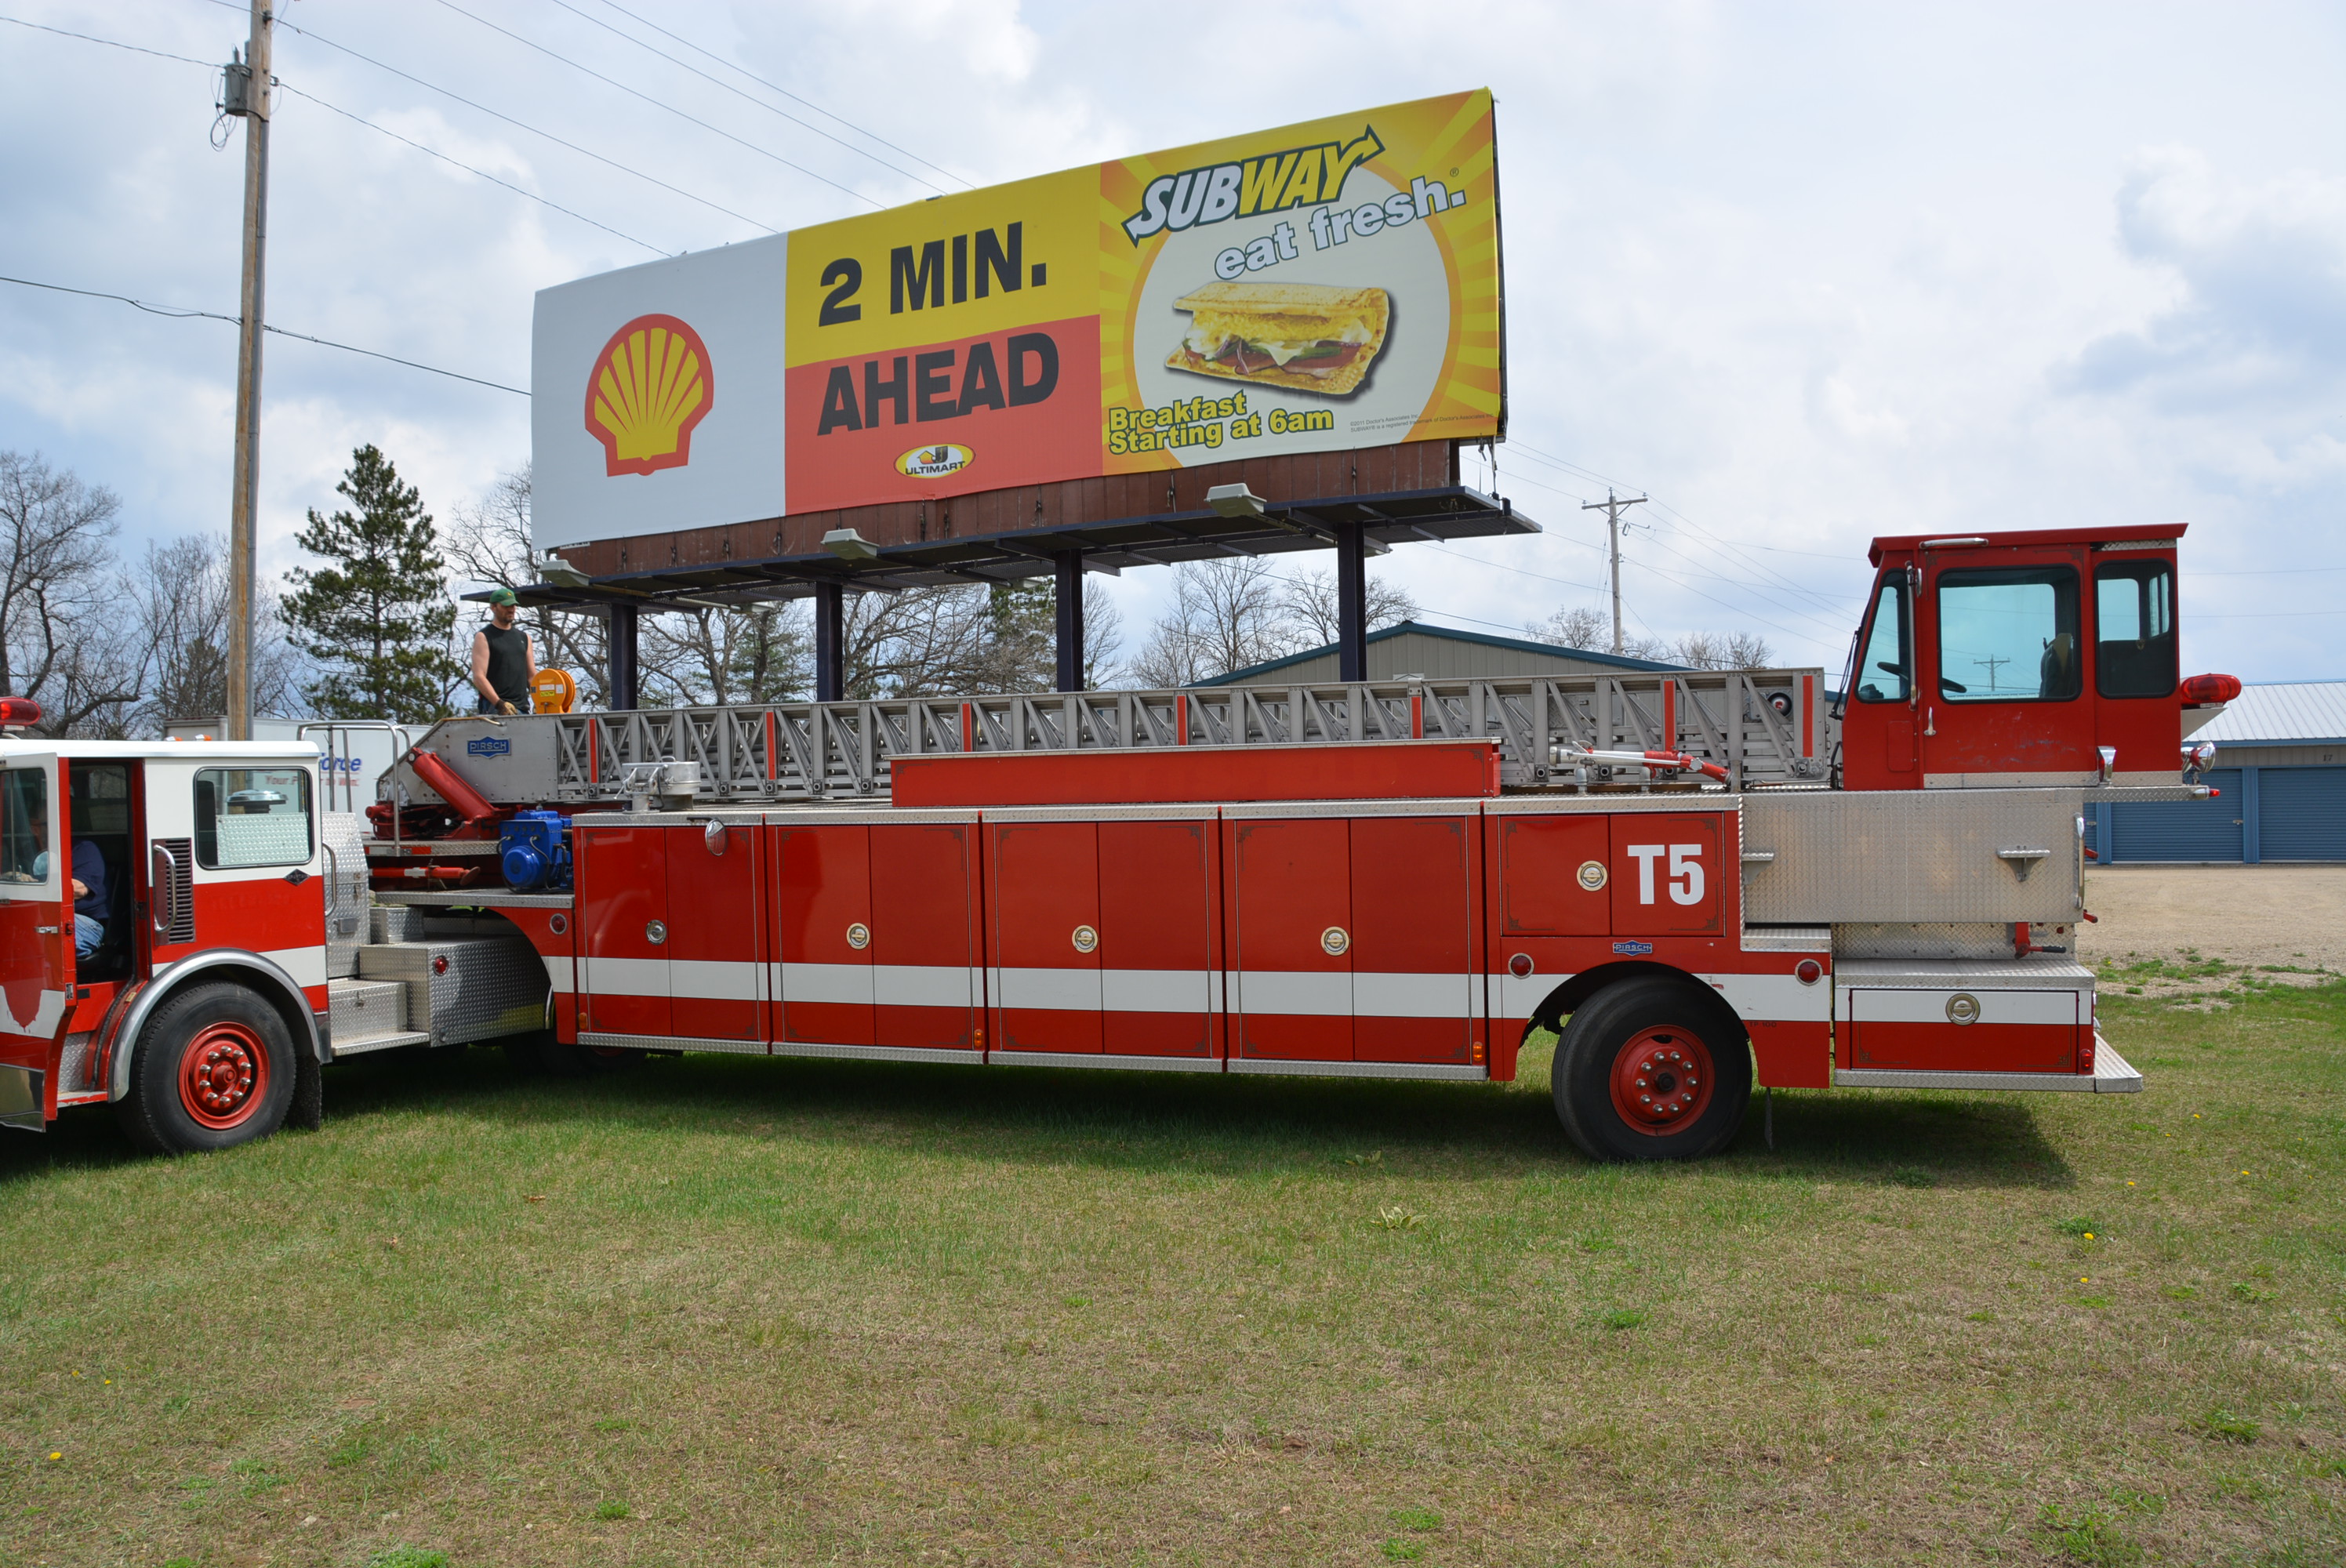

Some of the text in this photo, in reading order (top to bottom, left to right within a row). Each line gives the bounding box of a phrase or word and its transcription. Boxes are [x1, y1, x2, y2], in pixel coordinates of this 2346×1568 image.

[1121, 124, 1385, 248] SUBWAY
[819, 220, 1047, 327] 2 MIN.
[1215, 222, 1298, 279] eat
[816, 332, 1059, 436] AHEAD
[1108, 389, 1247, 433] Breakfast
[1109, 408, 1334, 455] Starting at 6am
[905, 461, 965, 475] ULTIMART
[318, 753, 361, 771] orce
[470, 742, 507, 752] PIRSCH
[1627, 844, 1705, 906] T5
